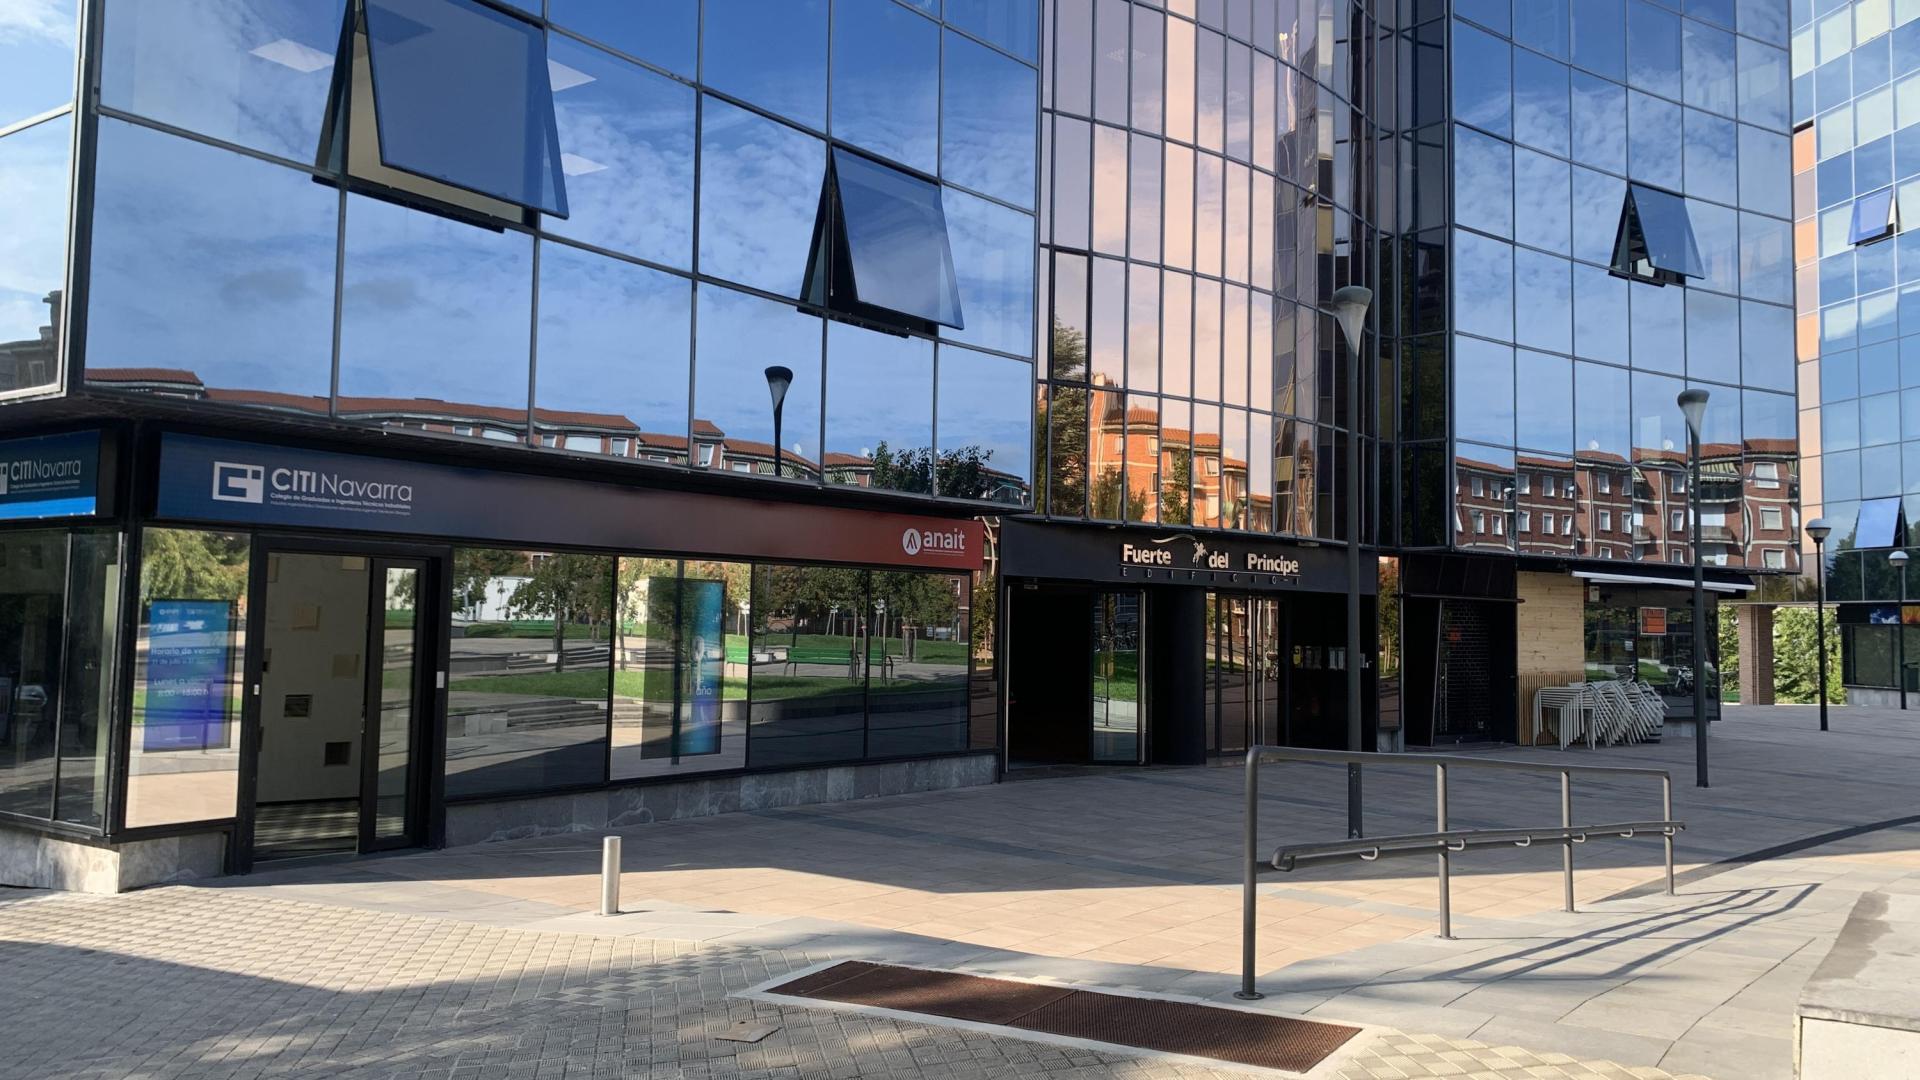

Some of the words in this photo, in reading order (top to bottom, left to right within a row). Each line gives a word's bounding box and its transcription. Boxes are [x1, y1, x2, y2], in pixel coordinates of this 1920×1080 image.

[33, 459, 81, 479] Navarra
[271, 468, 316, 493] CITI
[321, 474, 412, 501] Navarra
[923, 528, 965, 550] anait
[1123, 544, 1172, 565] Fuerte
[1208, 551, 1229, 569] del
[1247, 553, 1299, 576] Principe
